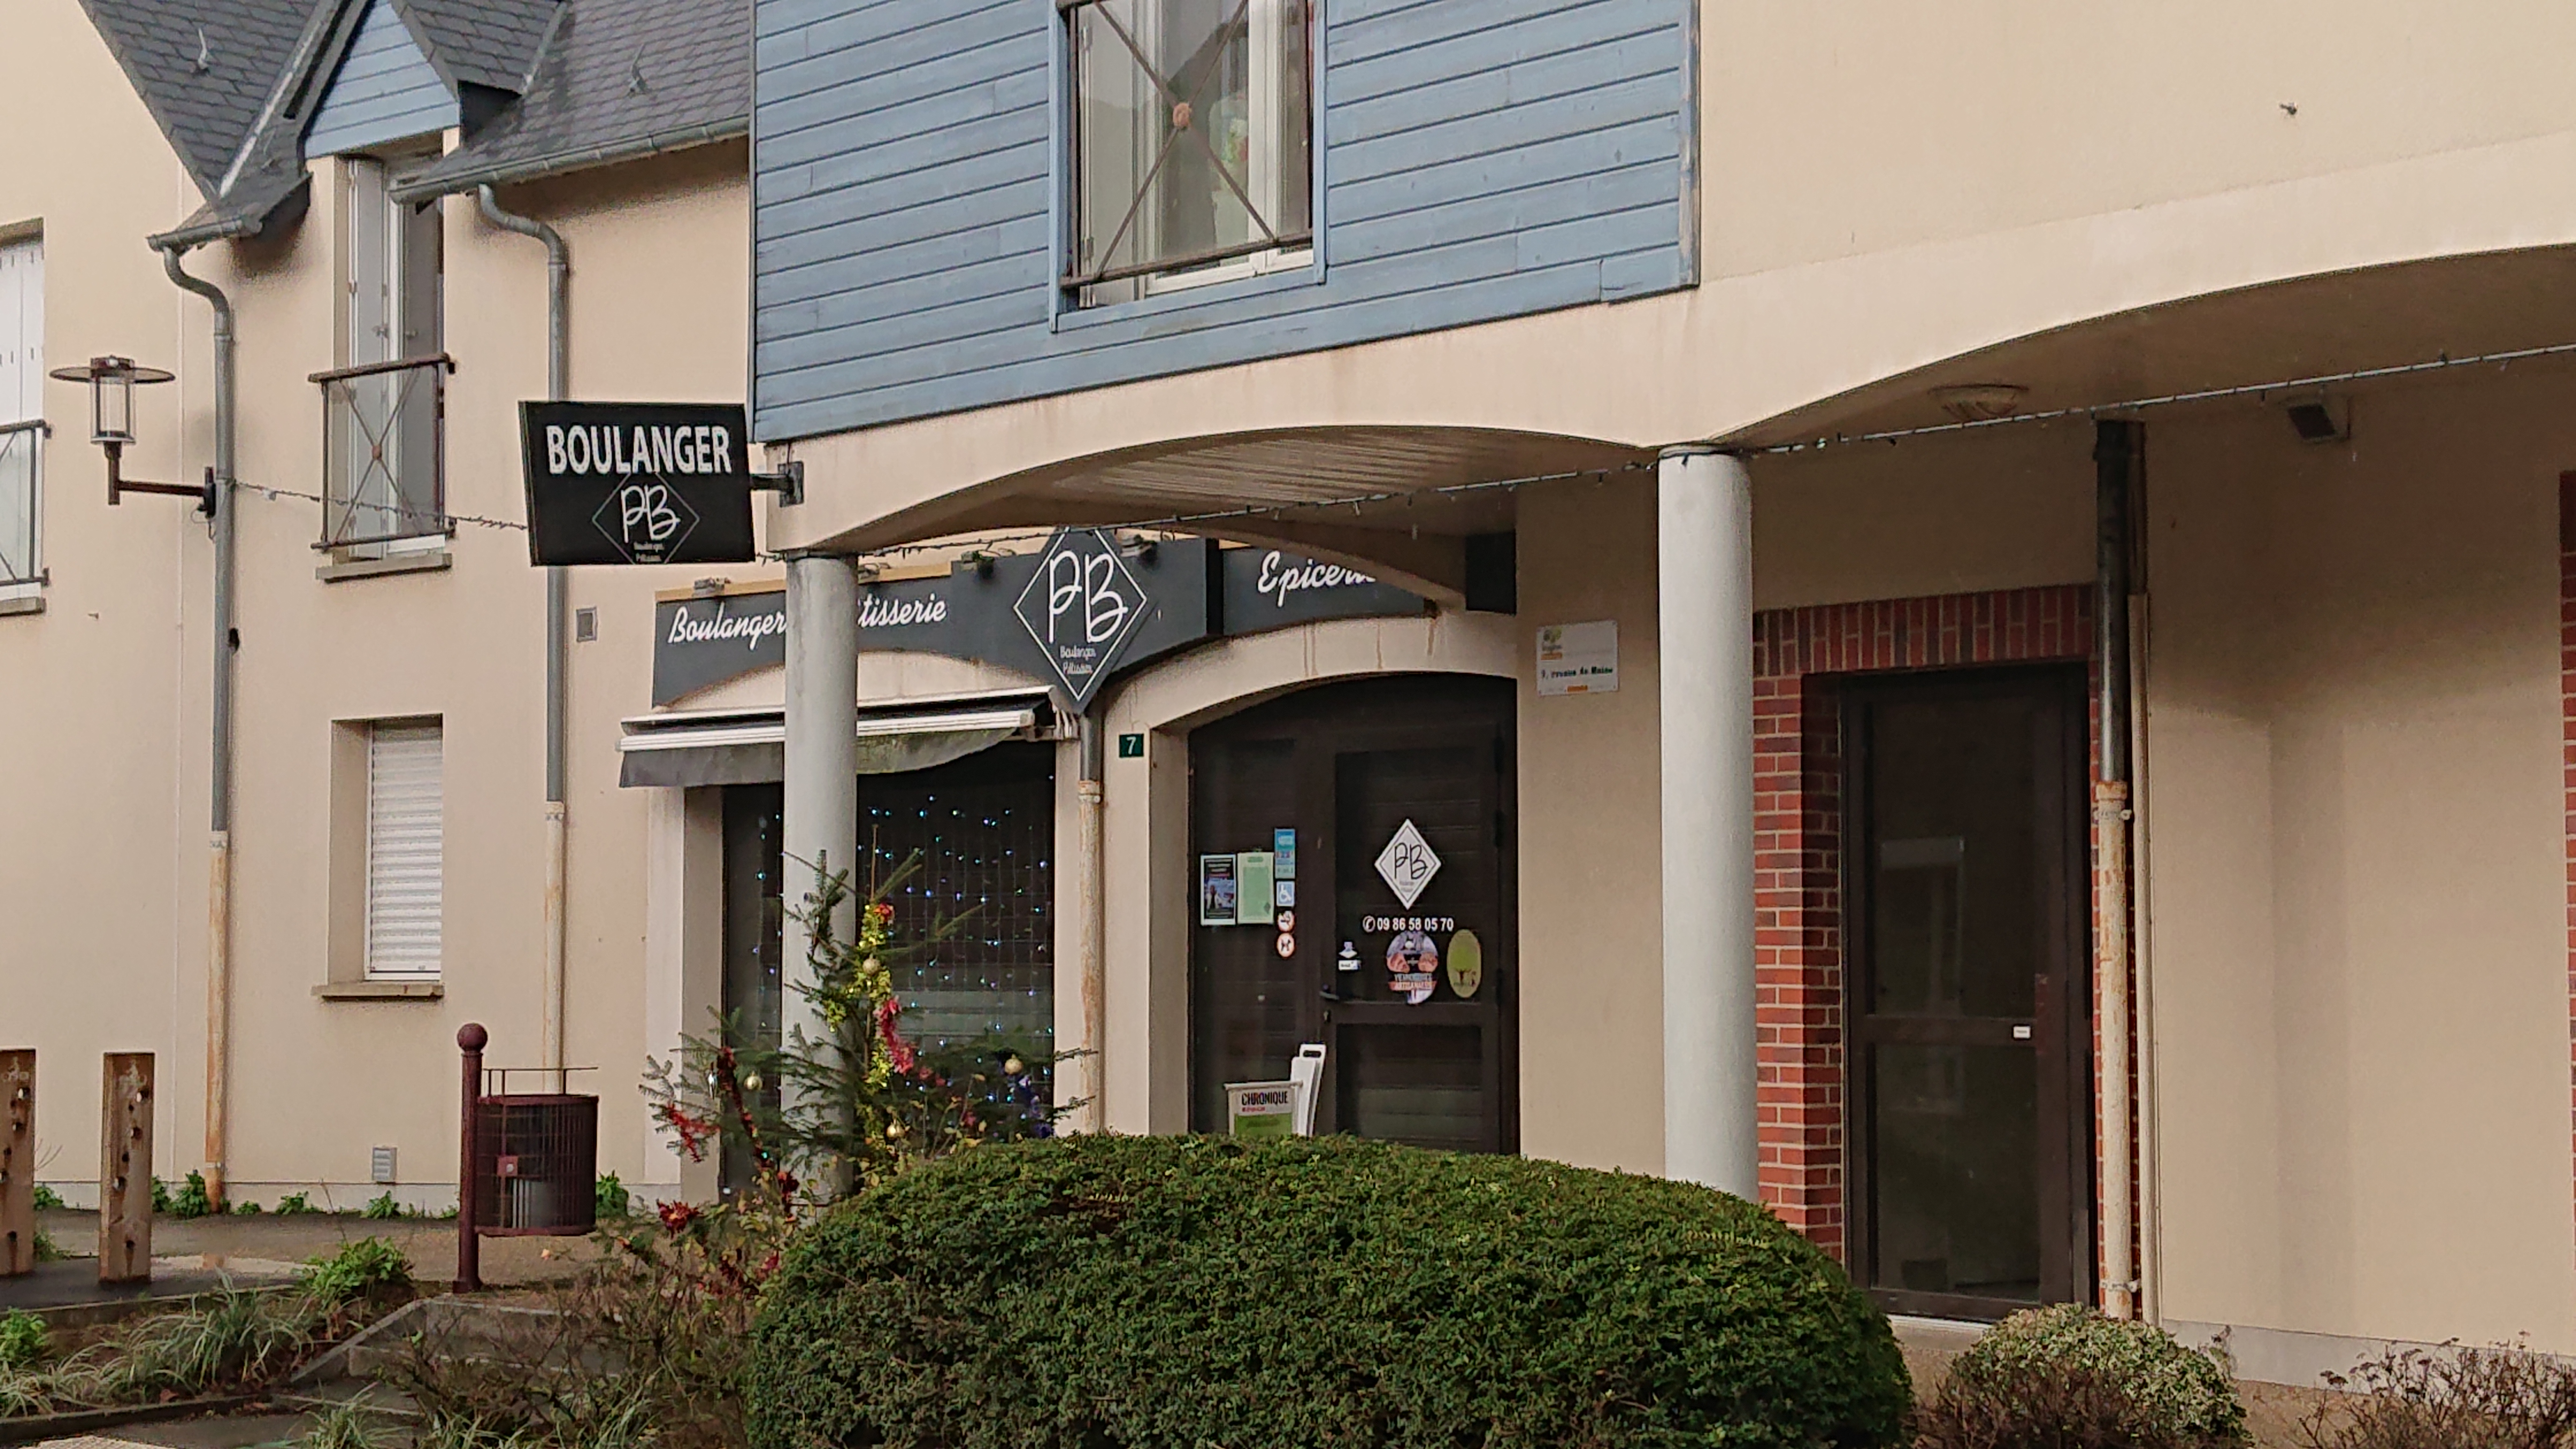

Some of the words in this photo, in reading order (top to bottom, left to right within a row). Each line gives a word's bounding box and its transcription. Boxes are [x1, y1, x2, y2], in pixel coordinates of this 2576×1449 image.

[546, 425, 732, 475] BOULANGER
[621, 484, 681, 543] PB
[1049, 550, 1128, 643] PB
[1258, 550, 1376, 607] Epicer
[668, 601, 787, 651] Boulanger
[857, 593, 947, 627] tisserie
[1127, 736, 1136, 755] 7
[1394, 842, 1428, 879] PB
[1377, 917, 1390, 931] 09
[1392, 917, 1406, 931] 86
[1409, 917, 1422, 931] 58
[1424, 917, 1438, 931] 05
[1440, 917, 1454, 931] 70
[1242, 1090, 1288, 1106] CHRONIQUE
